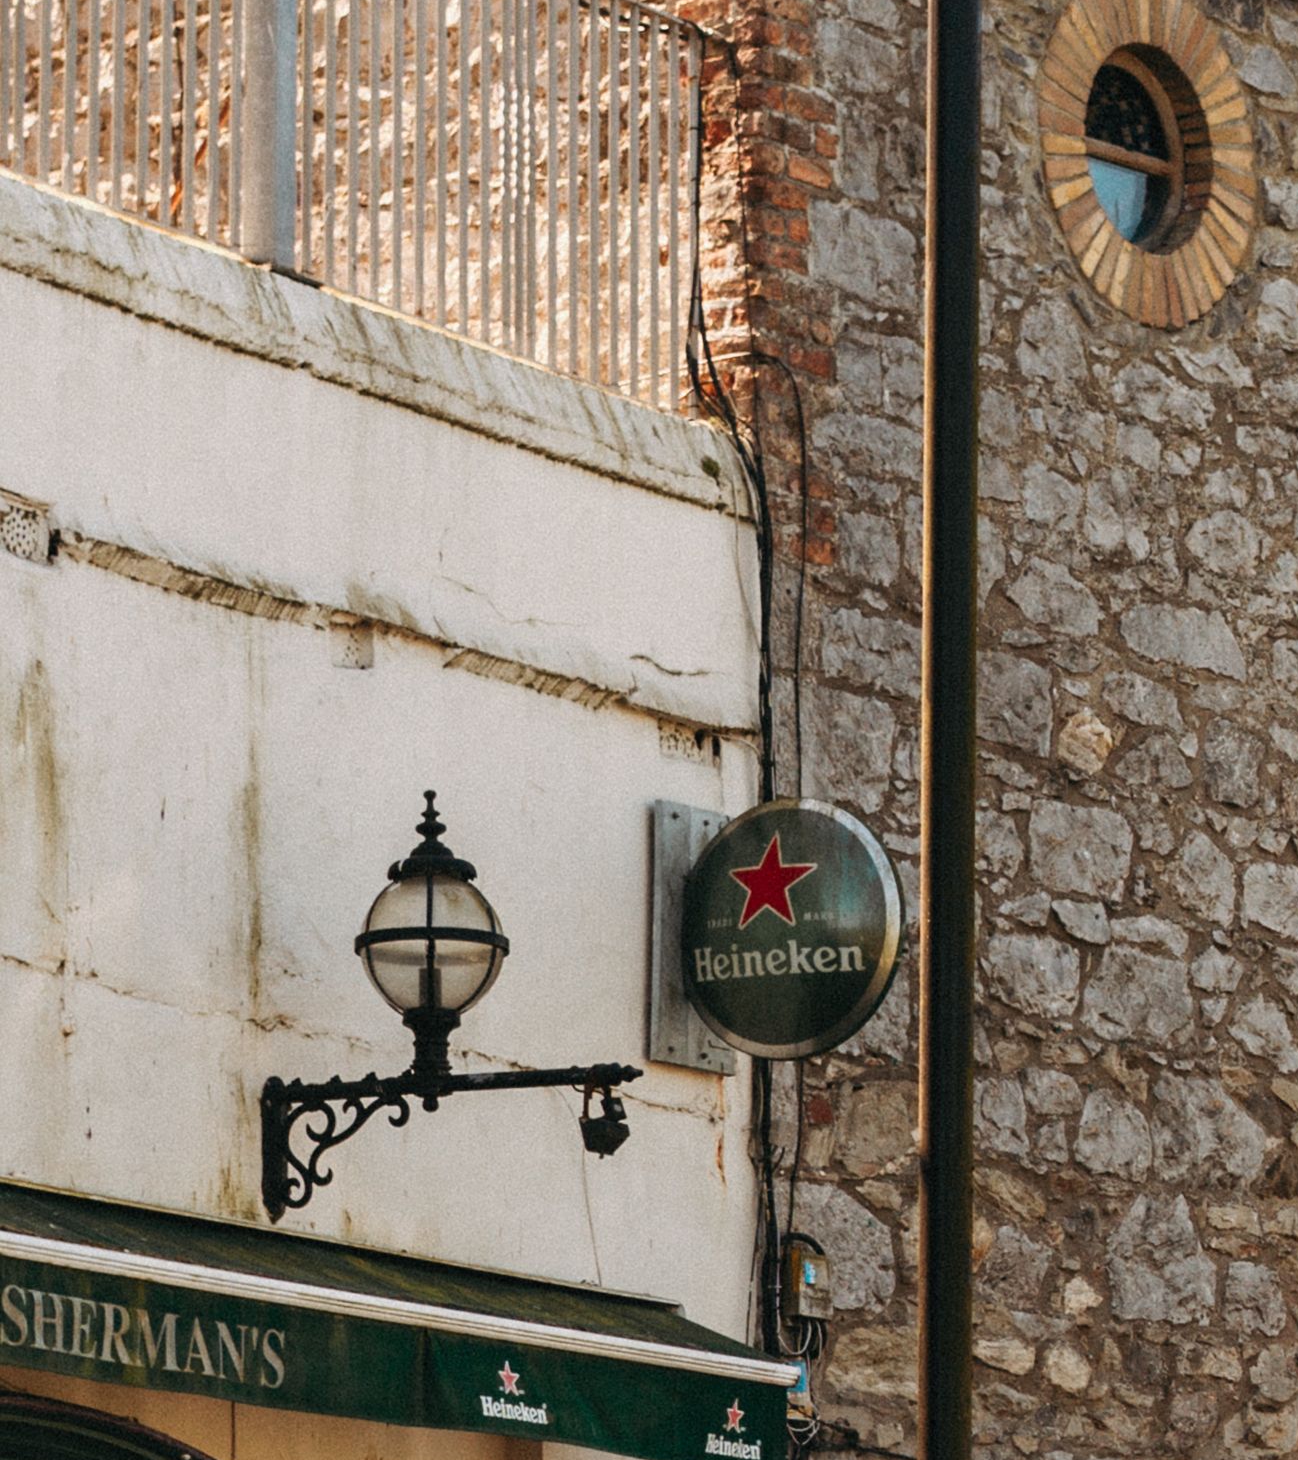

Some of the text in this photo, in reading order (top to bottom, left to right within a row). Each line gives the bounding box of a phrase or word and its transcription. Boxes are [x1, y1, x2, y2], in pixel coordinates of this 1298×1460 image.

[694, 940, 867, 982] Heineken
[0, 1284, 286, 1389] SHERMAN'S
[480, 1395, 549, 1425] Heineken
